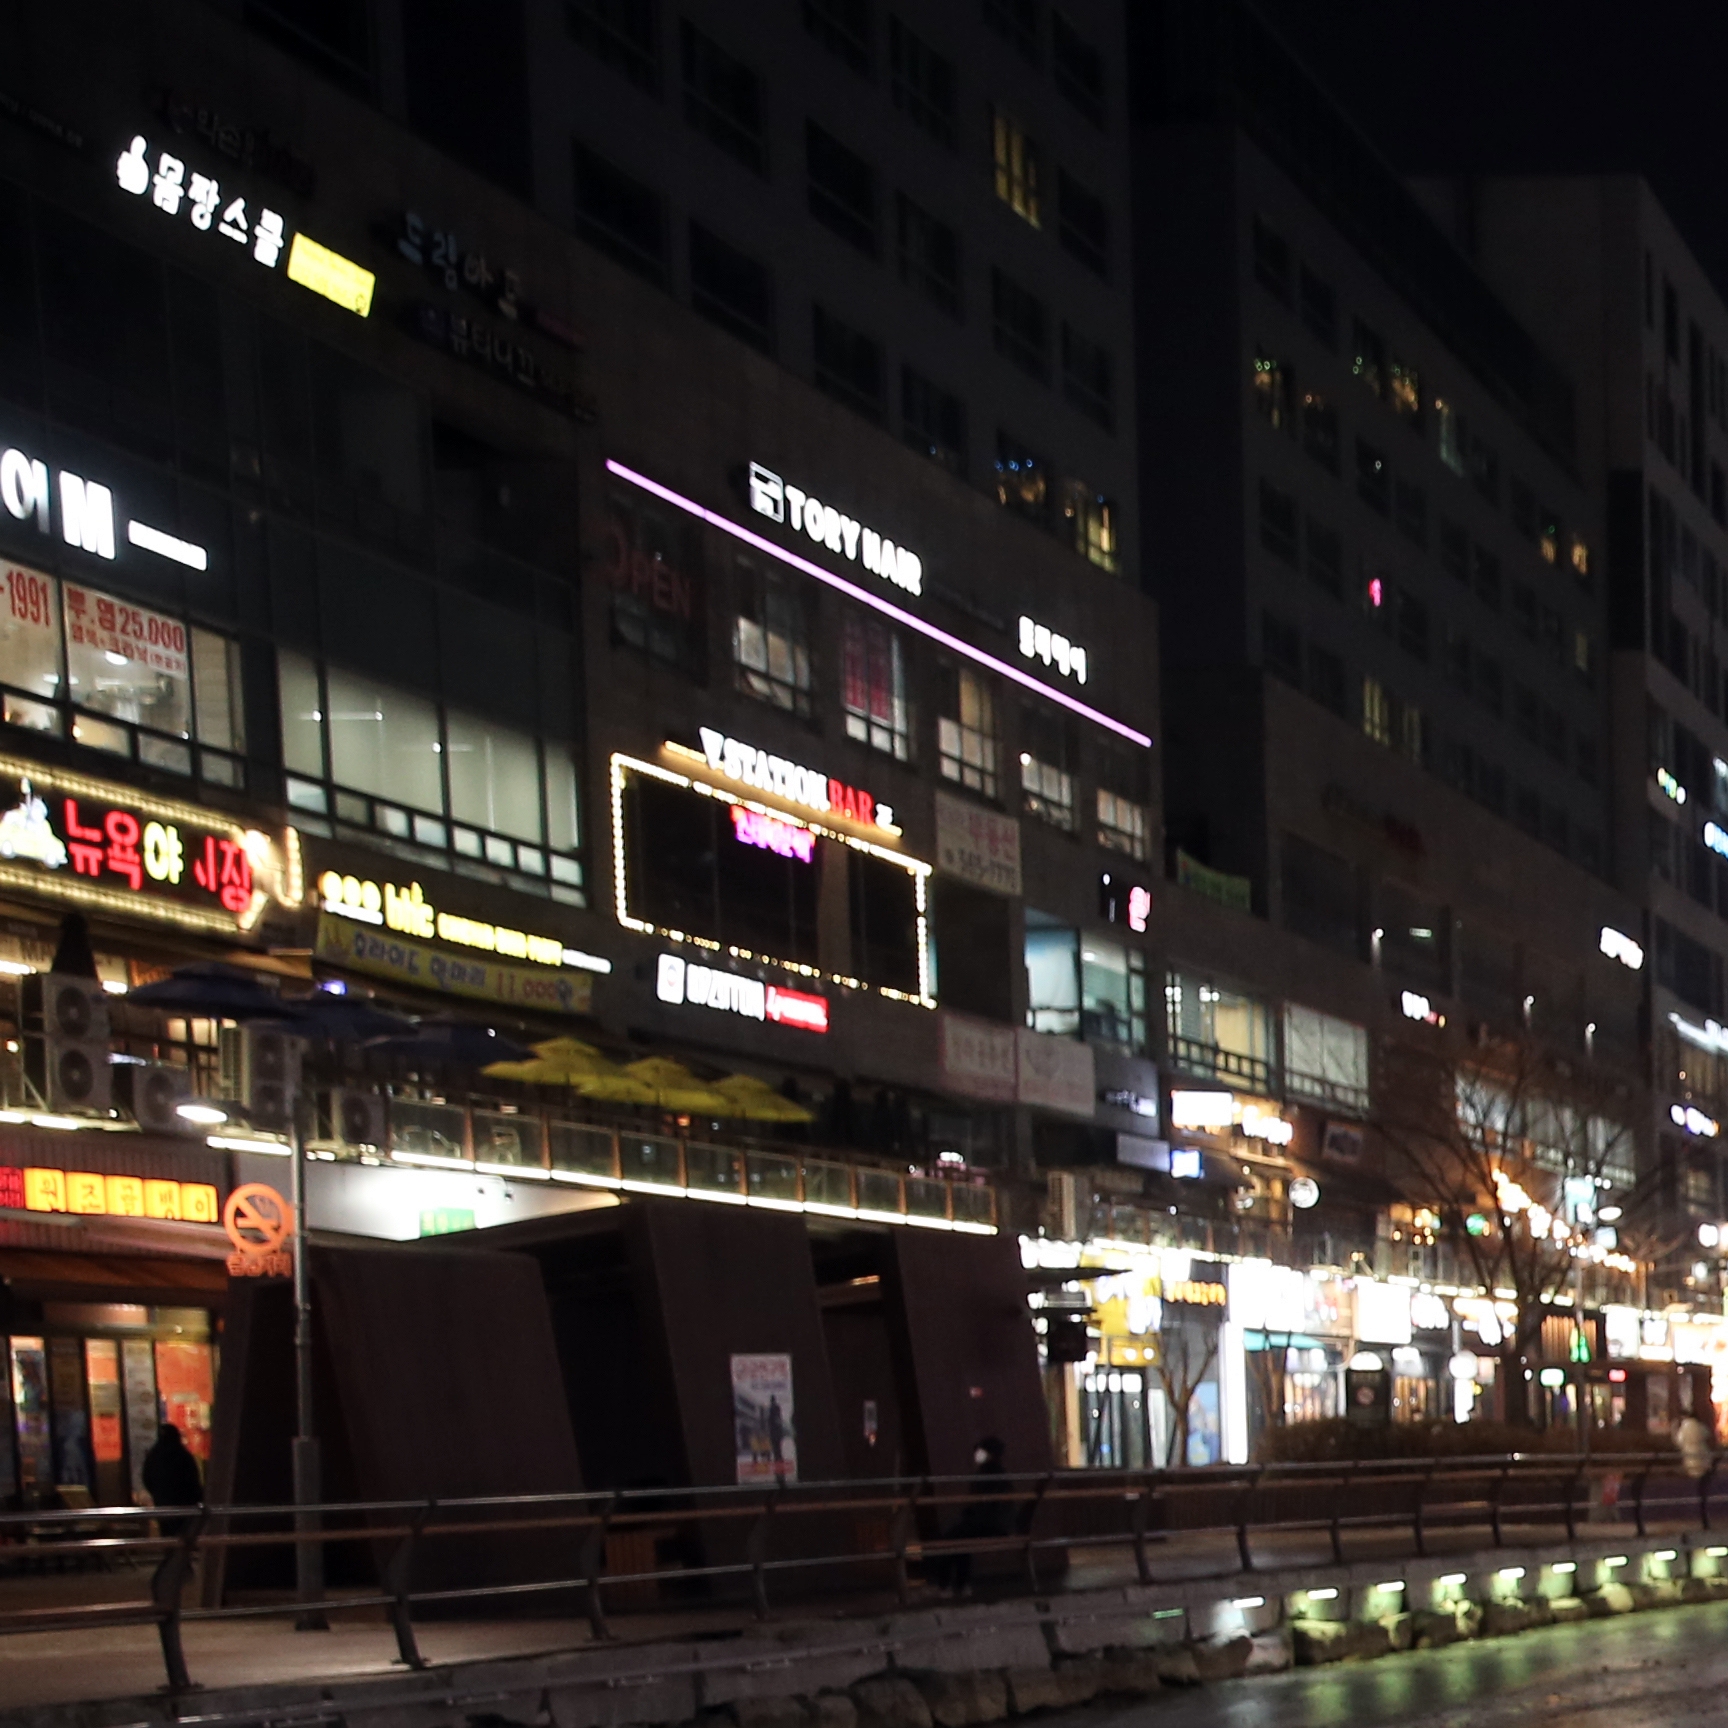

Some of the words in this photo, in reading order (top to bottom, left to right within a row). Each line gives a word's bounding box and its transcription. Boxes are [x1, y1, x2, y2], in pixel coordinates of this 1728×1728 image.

[785, 486, 860, 560] TORY
[861, 531, 923, 596] HAIR
[828, 777, 873, 825] BAR
